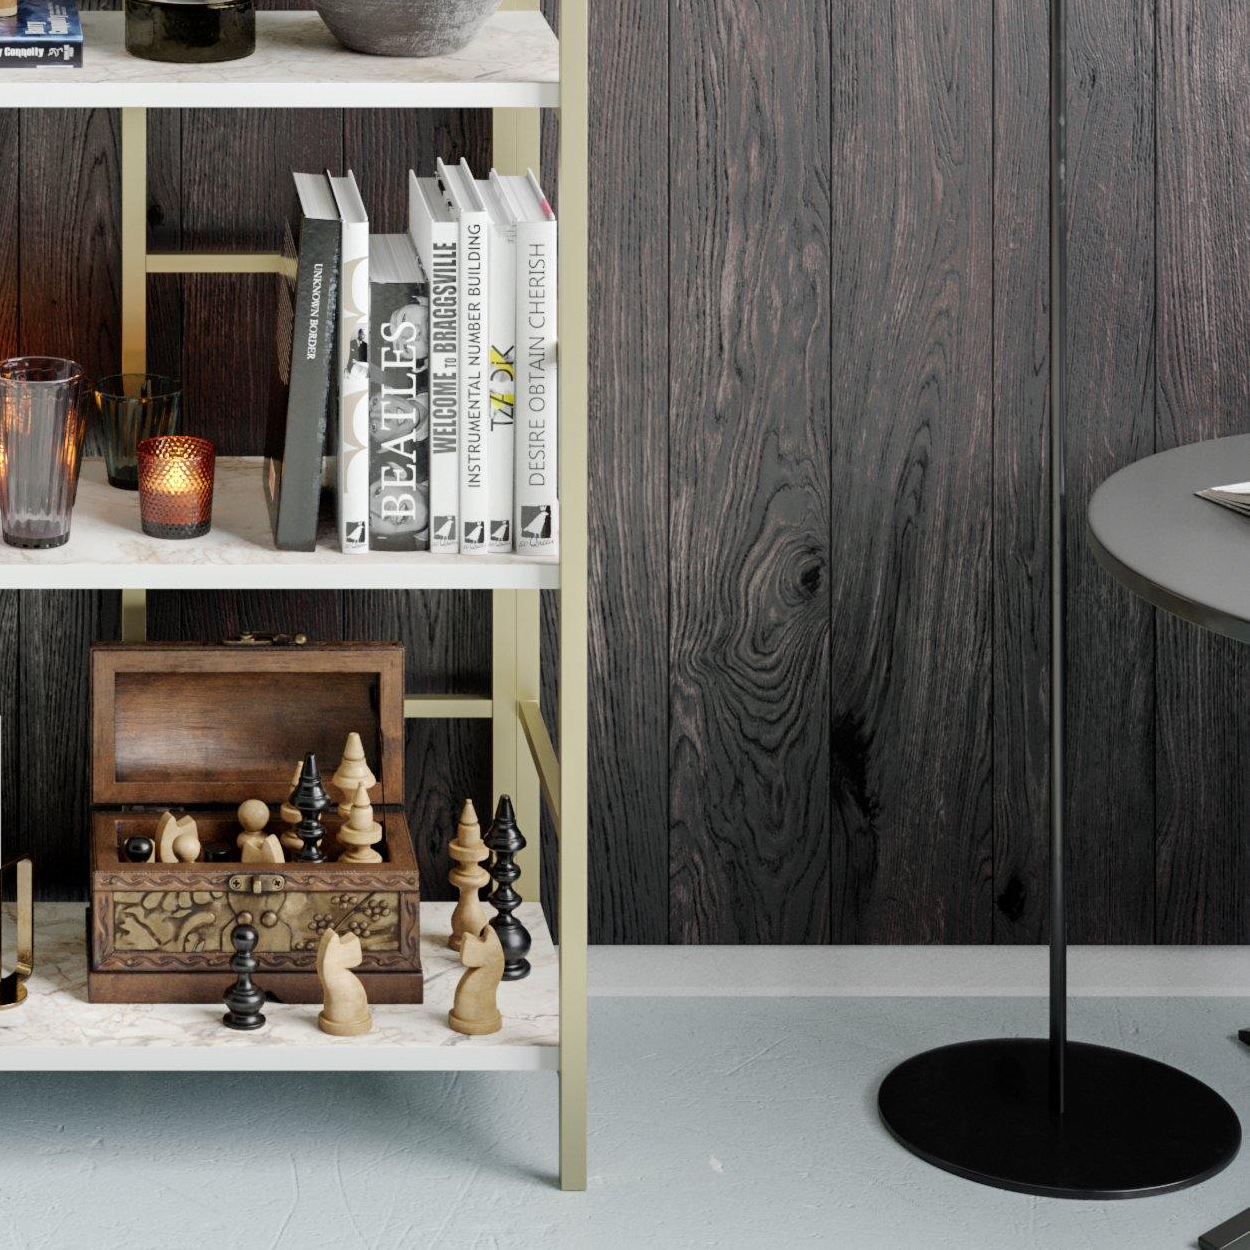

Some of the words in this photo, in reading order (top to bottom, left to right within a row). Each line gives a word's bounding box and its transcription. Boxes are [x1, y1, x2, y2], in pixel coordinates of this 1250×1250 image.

[310, 263, 324, 318] UNKNOWN
[467, 223, 482, 297] BUILDING
[528, 243, 546, 329] CHERISH
[432, 242, 457, 356] BRAGGSVILLE
[467, 301, 482, 367] NUMBER
[306, 318, 319, 360] BORDER
[445, 357, 457, 369] TO
[528, 336, 546, 413] OBTAIN
[380, 321, 418, 520] BEATLES
[432, 372, 457, 454] WELCOME
[467, 371, 482, 488] INSTRUMENTAL
[528, 419, 546, 487] DESIRE
